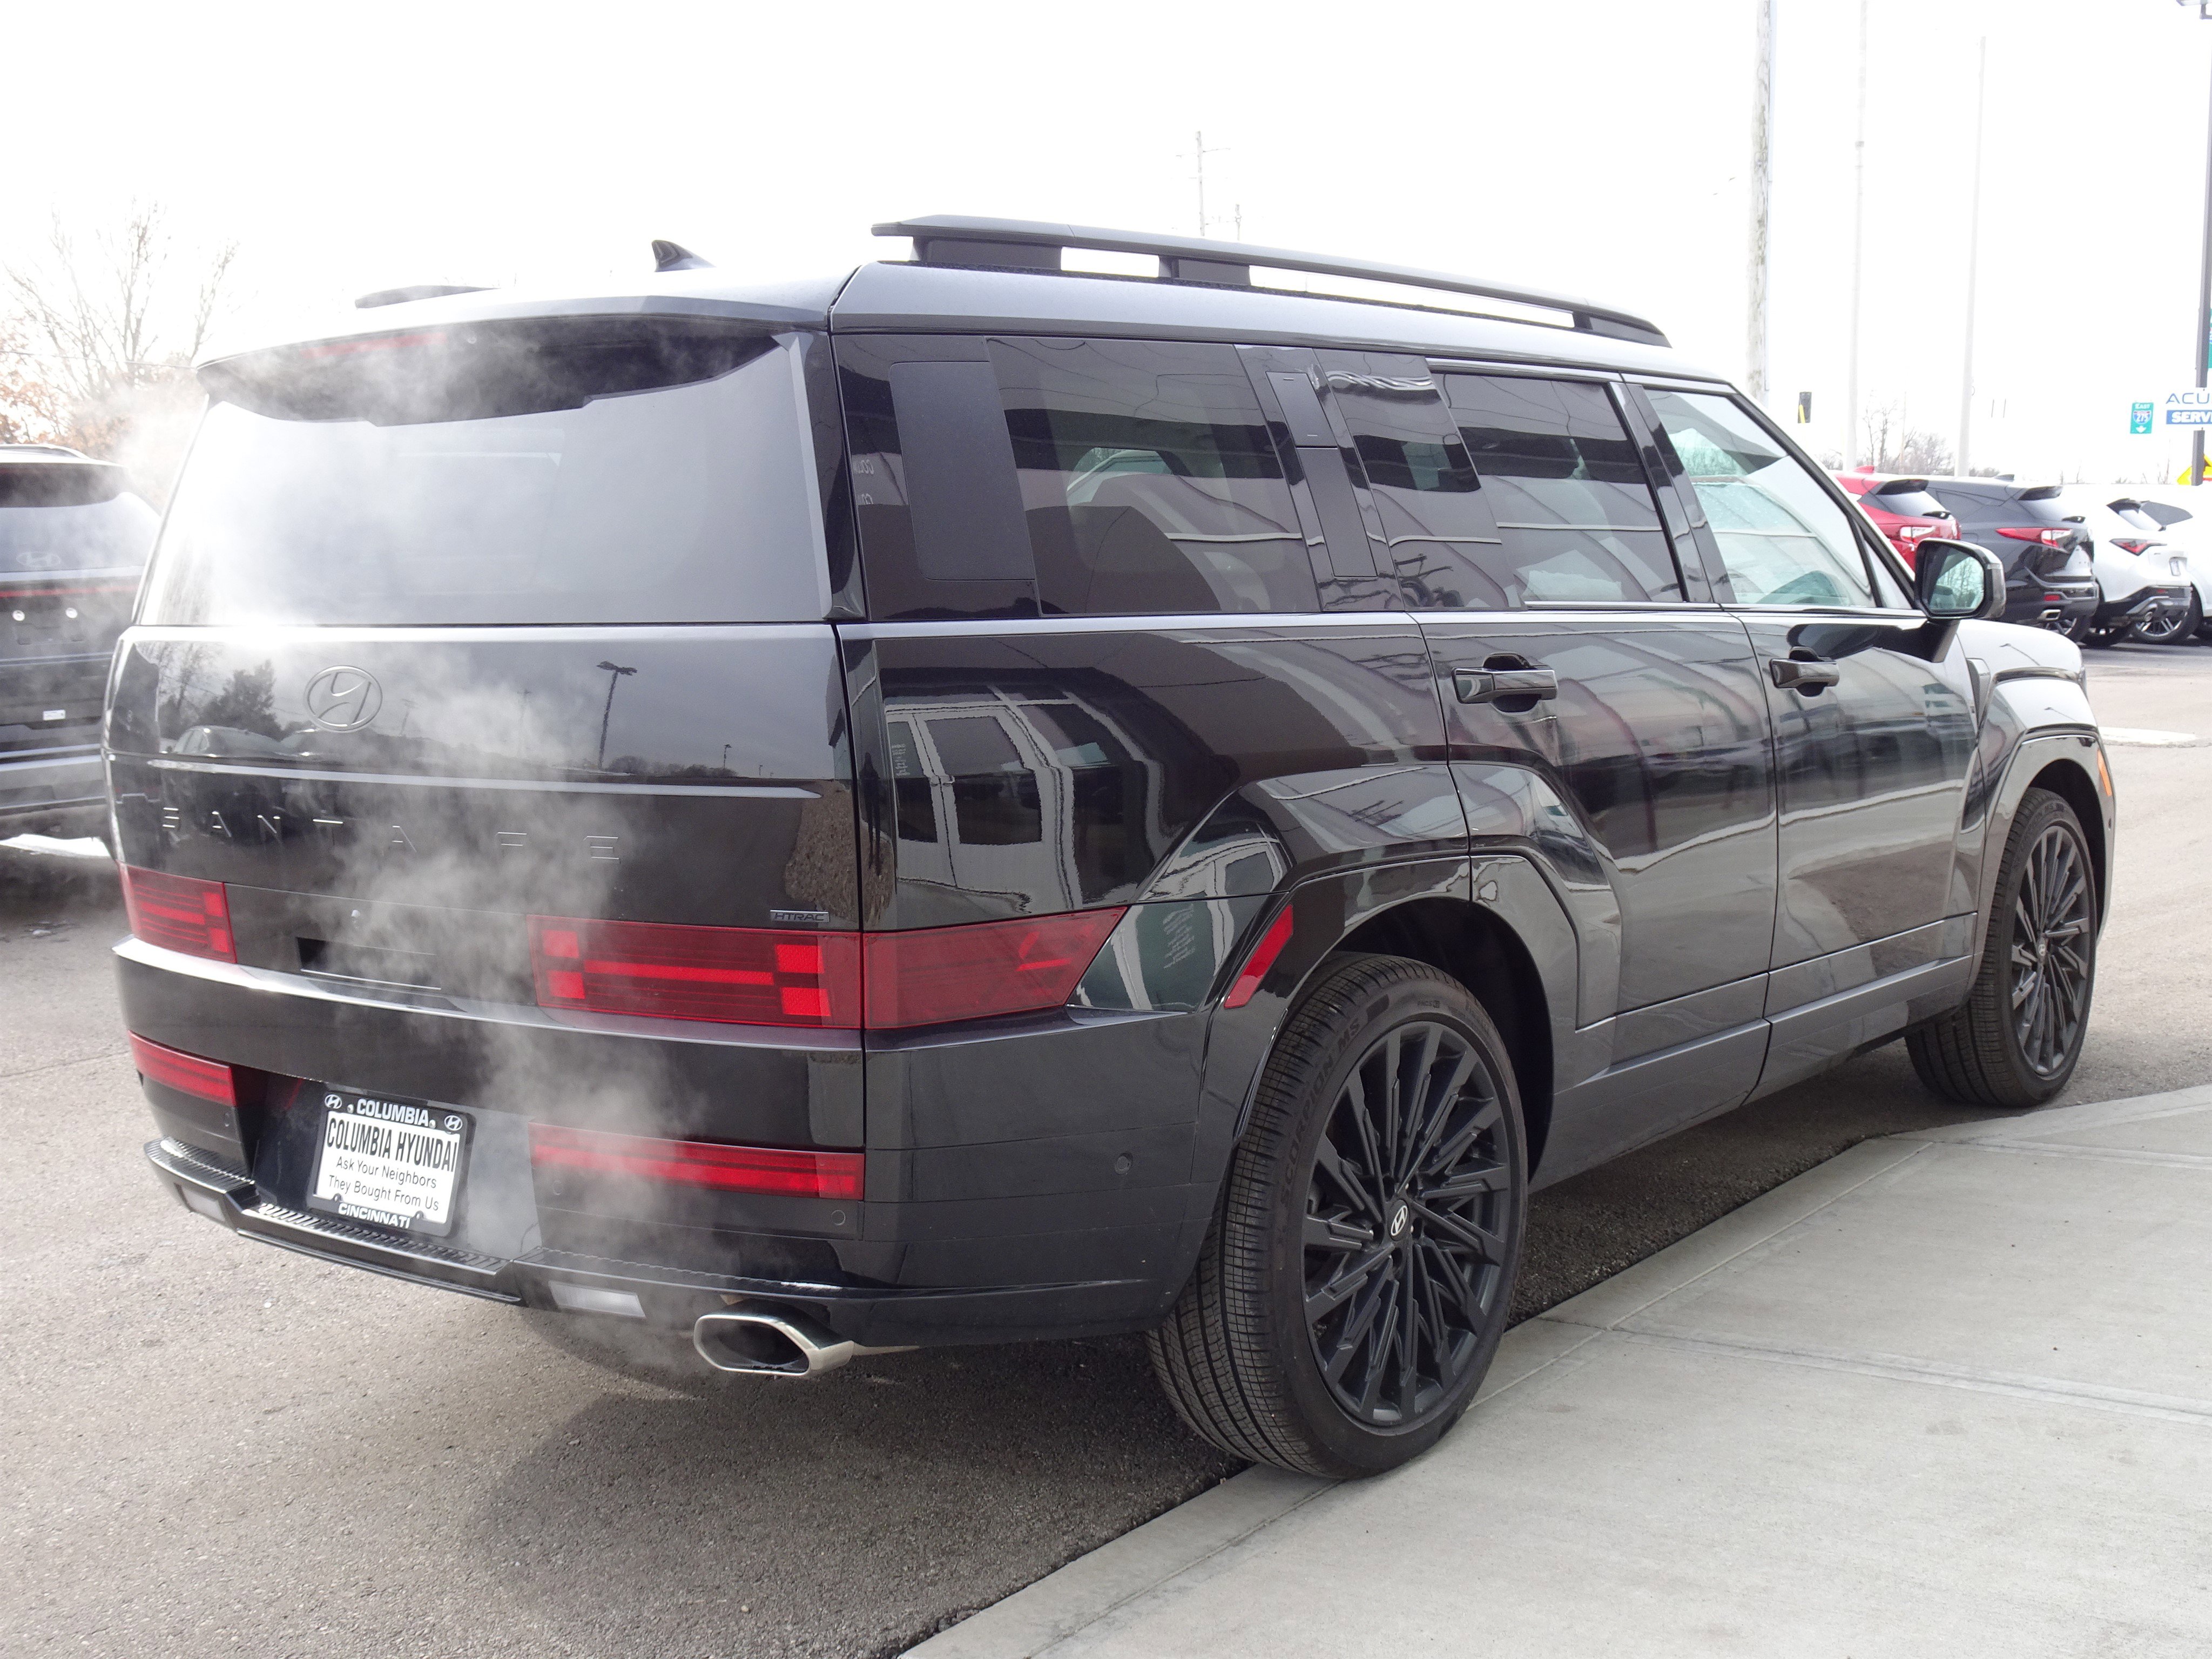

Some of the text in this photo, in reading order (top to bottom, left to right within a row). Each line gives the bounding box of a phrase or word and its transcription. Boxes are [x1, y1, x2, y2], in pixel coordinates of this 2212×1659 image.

[2136, 414, 2148, 422] 275
[774, 913, 824, 921] HTRAC
[356, 1098, 429, 1127] COLUMBIA
[327, 1117, 458, 1172] COLUMBIA HYUNDAI
[336, 1156, 437, 1188] Ask Your Neighbors
[329, 1175, 439, 1211] They Bought From Us
[338, 1203, 410, 1229] CINCINNATI
